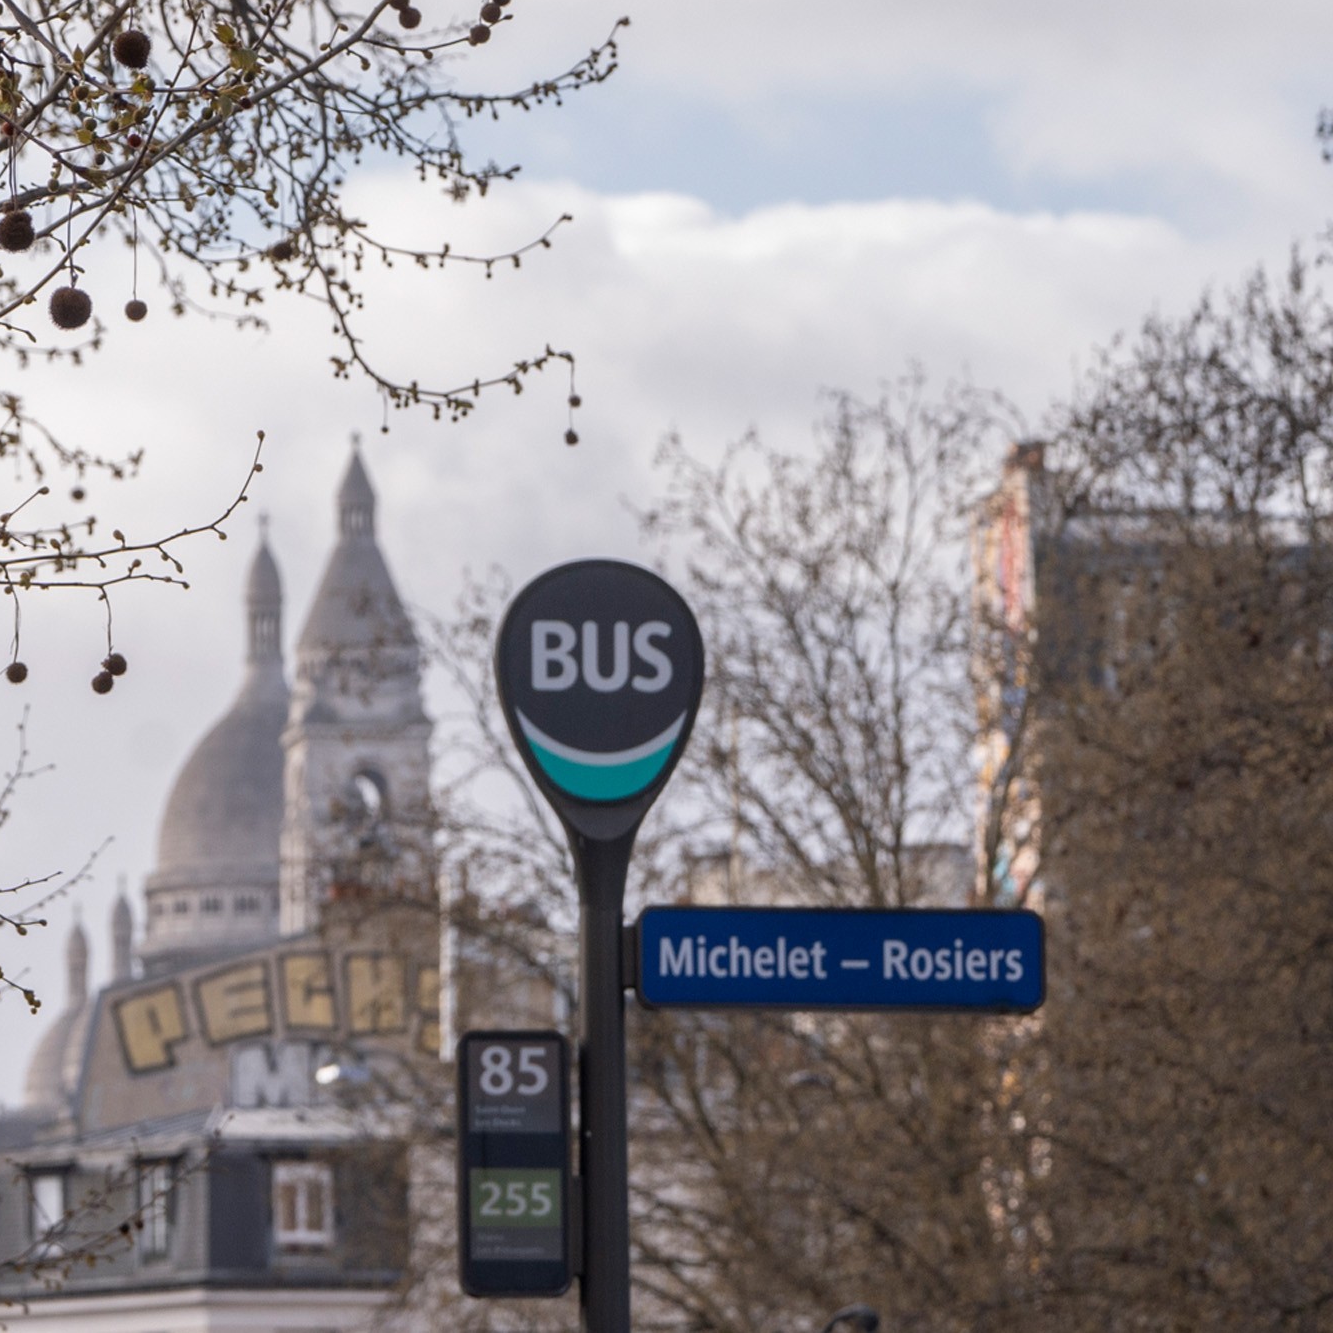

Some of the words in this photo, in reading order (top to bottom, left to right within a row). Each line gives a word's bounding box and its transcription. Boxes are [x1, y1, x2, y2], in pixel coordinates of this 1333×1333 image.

[532, 619, 673, 693] BUS
[659, 935, 827, 979] Michelet
[883, 938, 1024, 982] Rosiers
[480, 1046, 548, 1096] 85
[479, 1181, 552, 1217] 255
